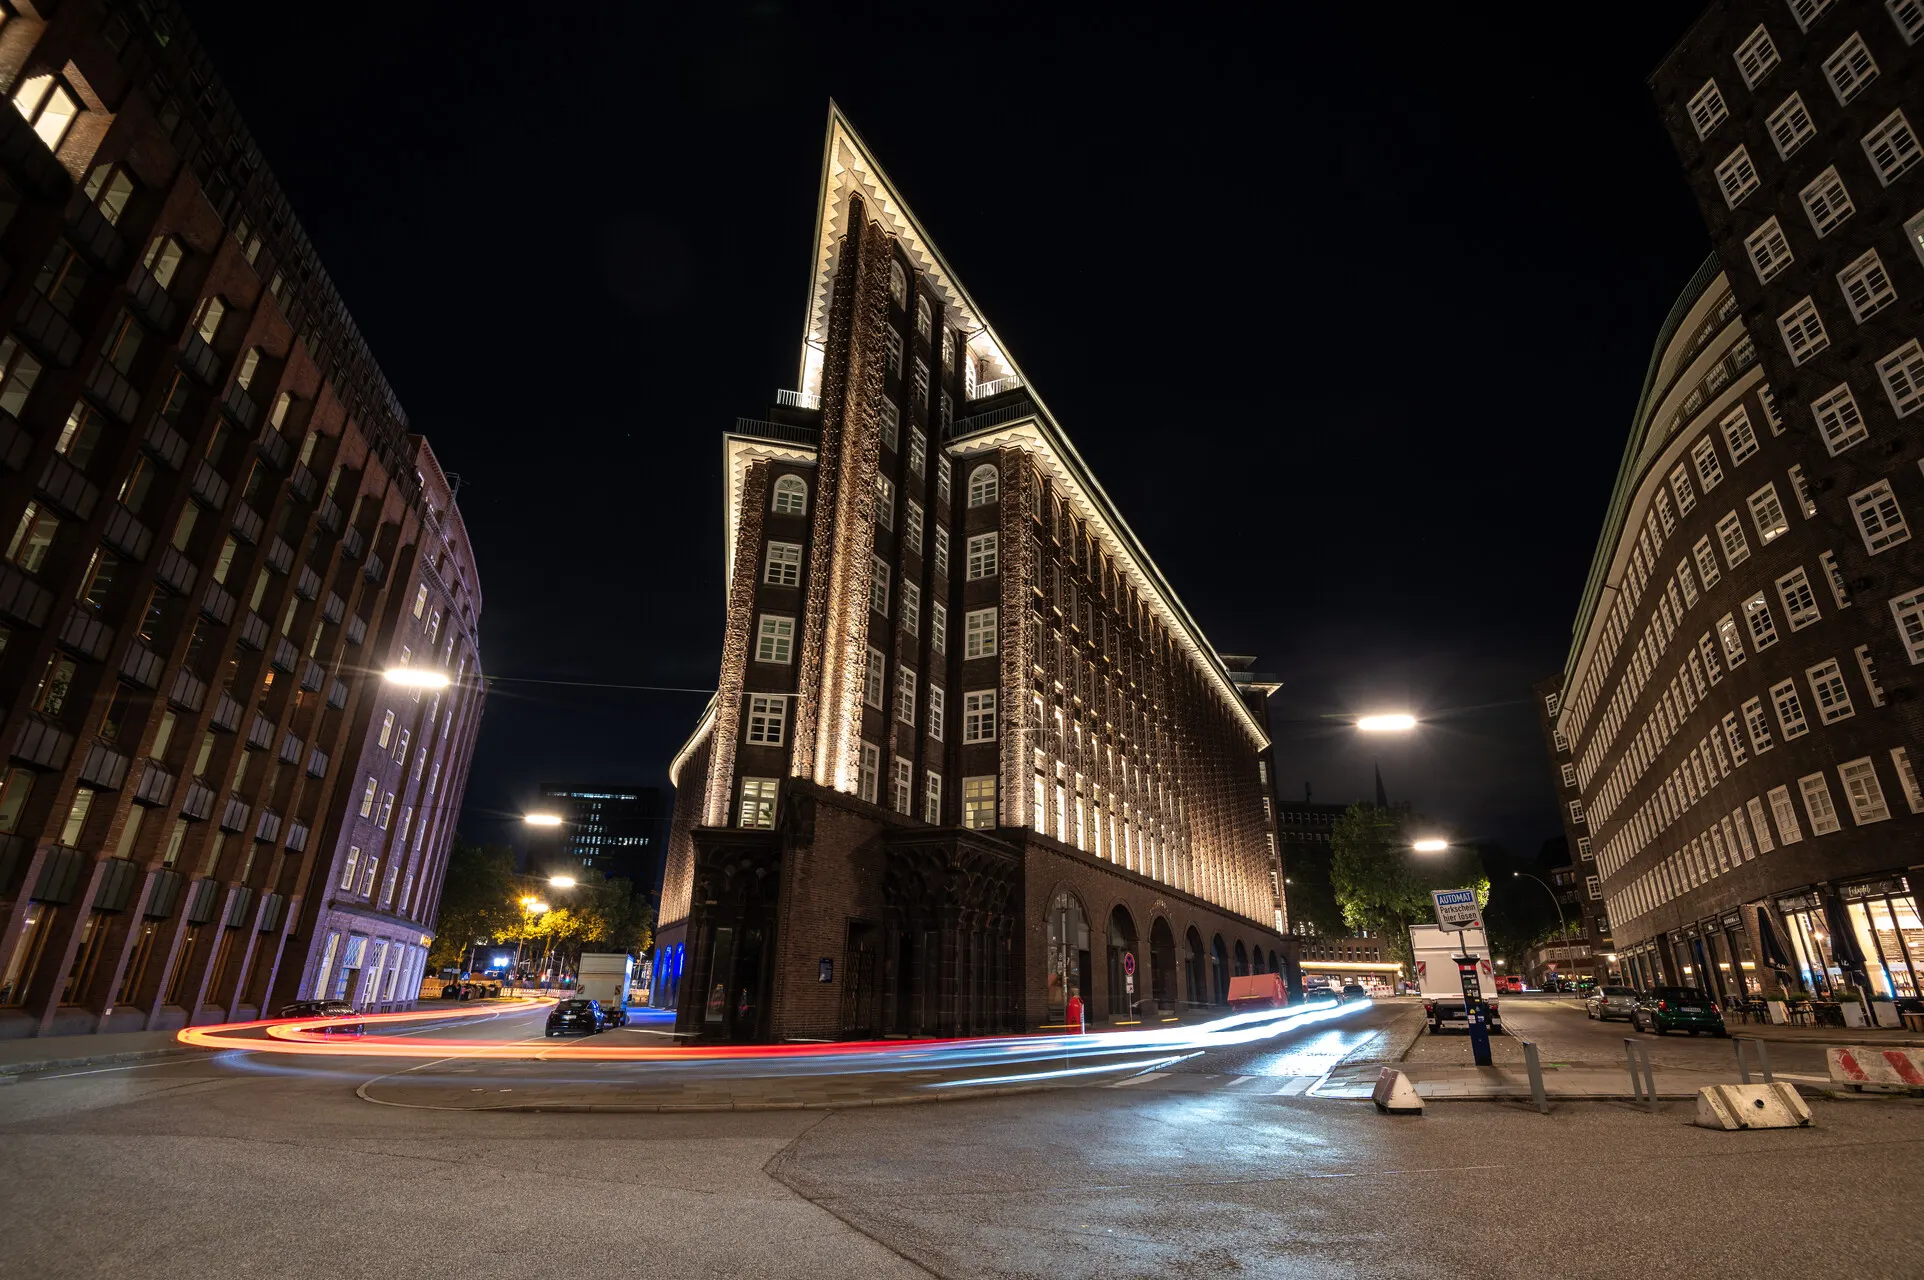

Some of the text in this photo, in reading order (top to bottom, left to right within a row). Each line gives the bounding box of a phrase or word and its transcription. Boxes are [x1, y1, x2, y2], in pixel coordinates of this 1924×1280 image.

[1439, 893, 1471, 904] AUTOMAT
[1440, 904, 1476, 914] Parkschein
[1443, 912, 1477, 922] hier lösen
